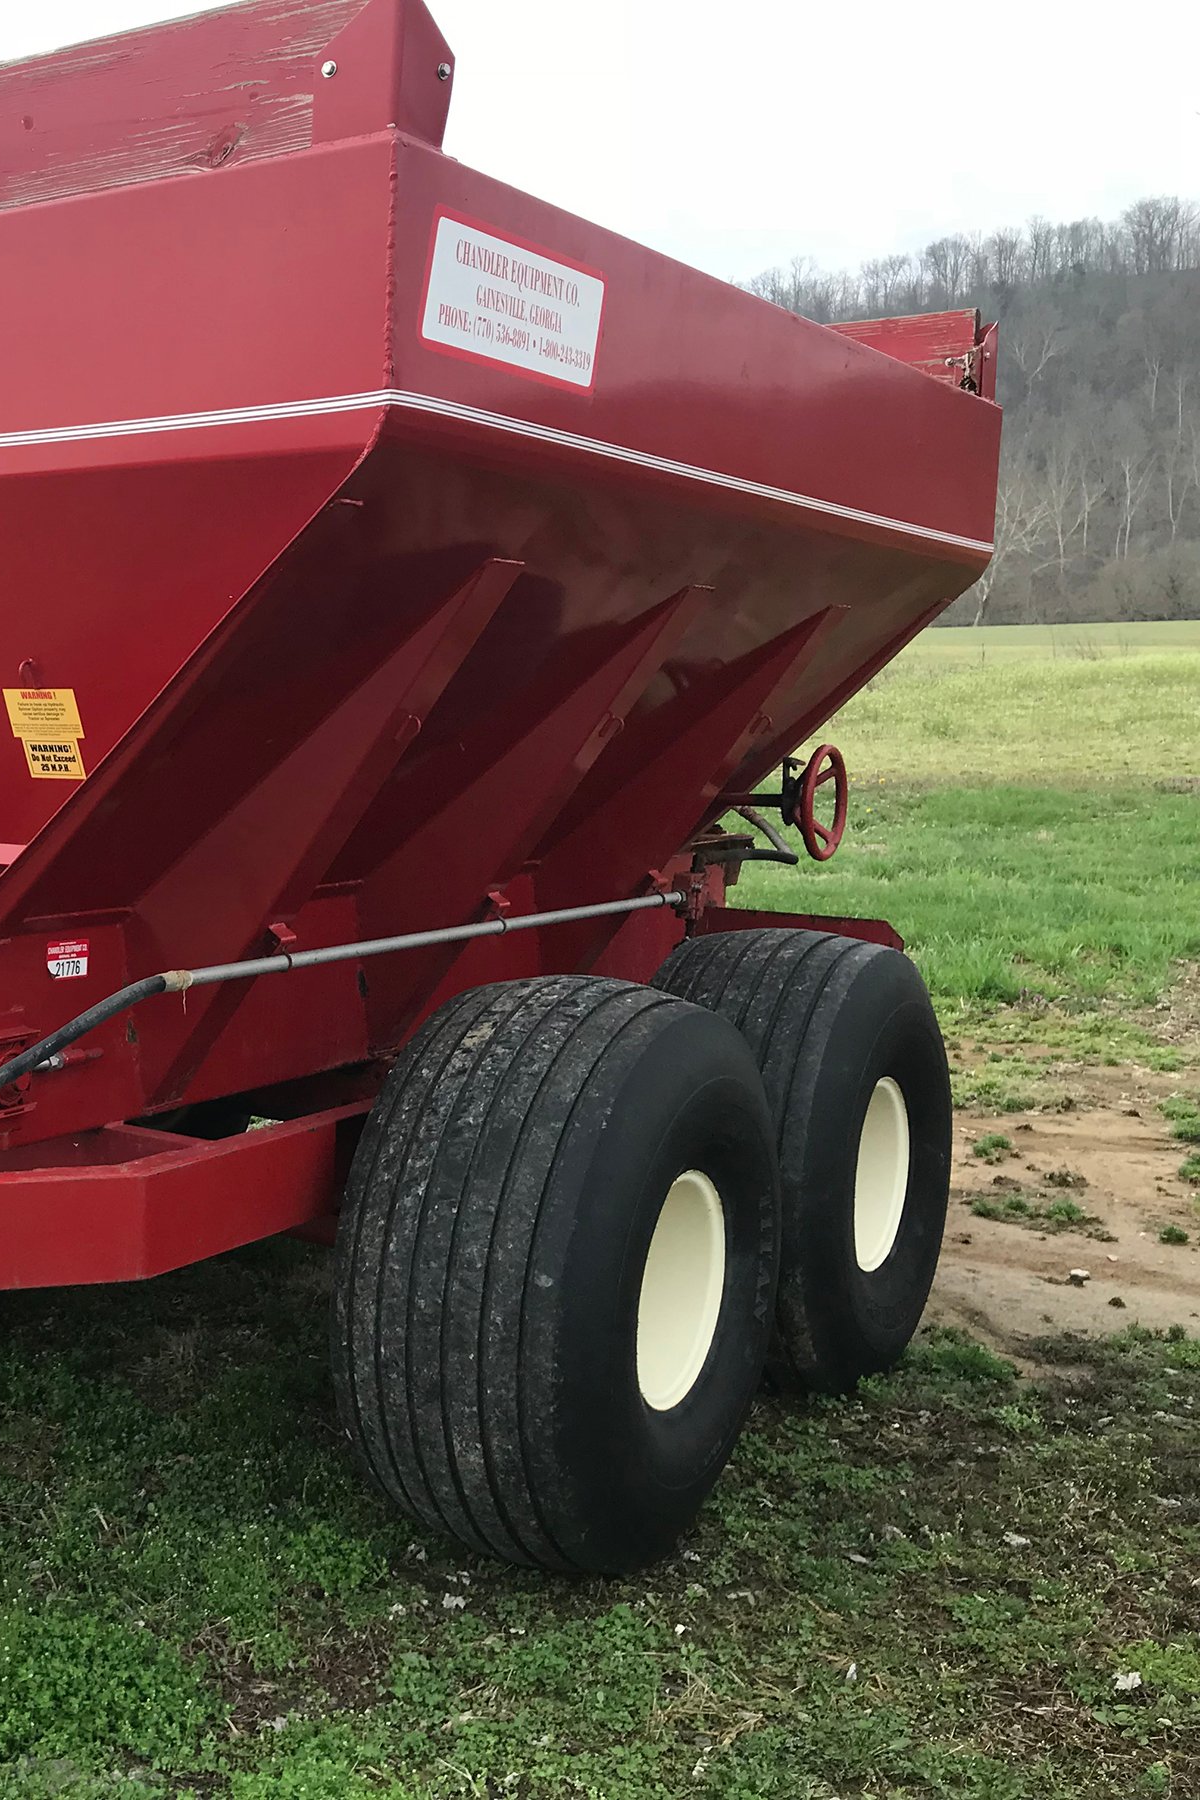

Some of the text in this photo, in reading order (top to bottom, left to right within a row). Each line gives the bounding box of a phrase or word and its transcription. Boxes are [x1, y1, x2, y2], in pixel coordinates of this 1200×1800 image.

[456, 238, 580, 307] CHANDLER EQUIPMENT CO.
[476, 284, 562, 334] GAINESVILLE, GEORGIA
[438, 303, 591, 372] PHONE: (770) 536-8891 1-800-243-3319
[30, 744, 72, 753] WARNING!
[41, 754, 51, 762] Not
[53, 754, 76, 762] Exceed
[41, 763, 71, 772] 25 M.P.H.
[56, 960, 80, 976] 21776
